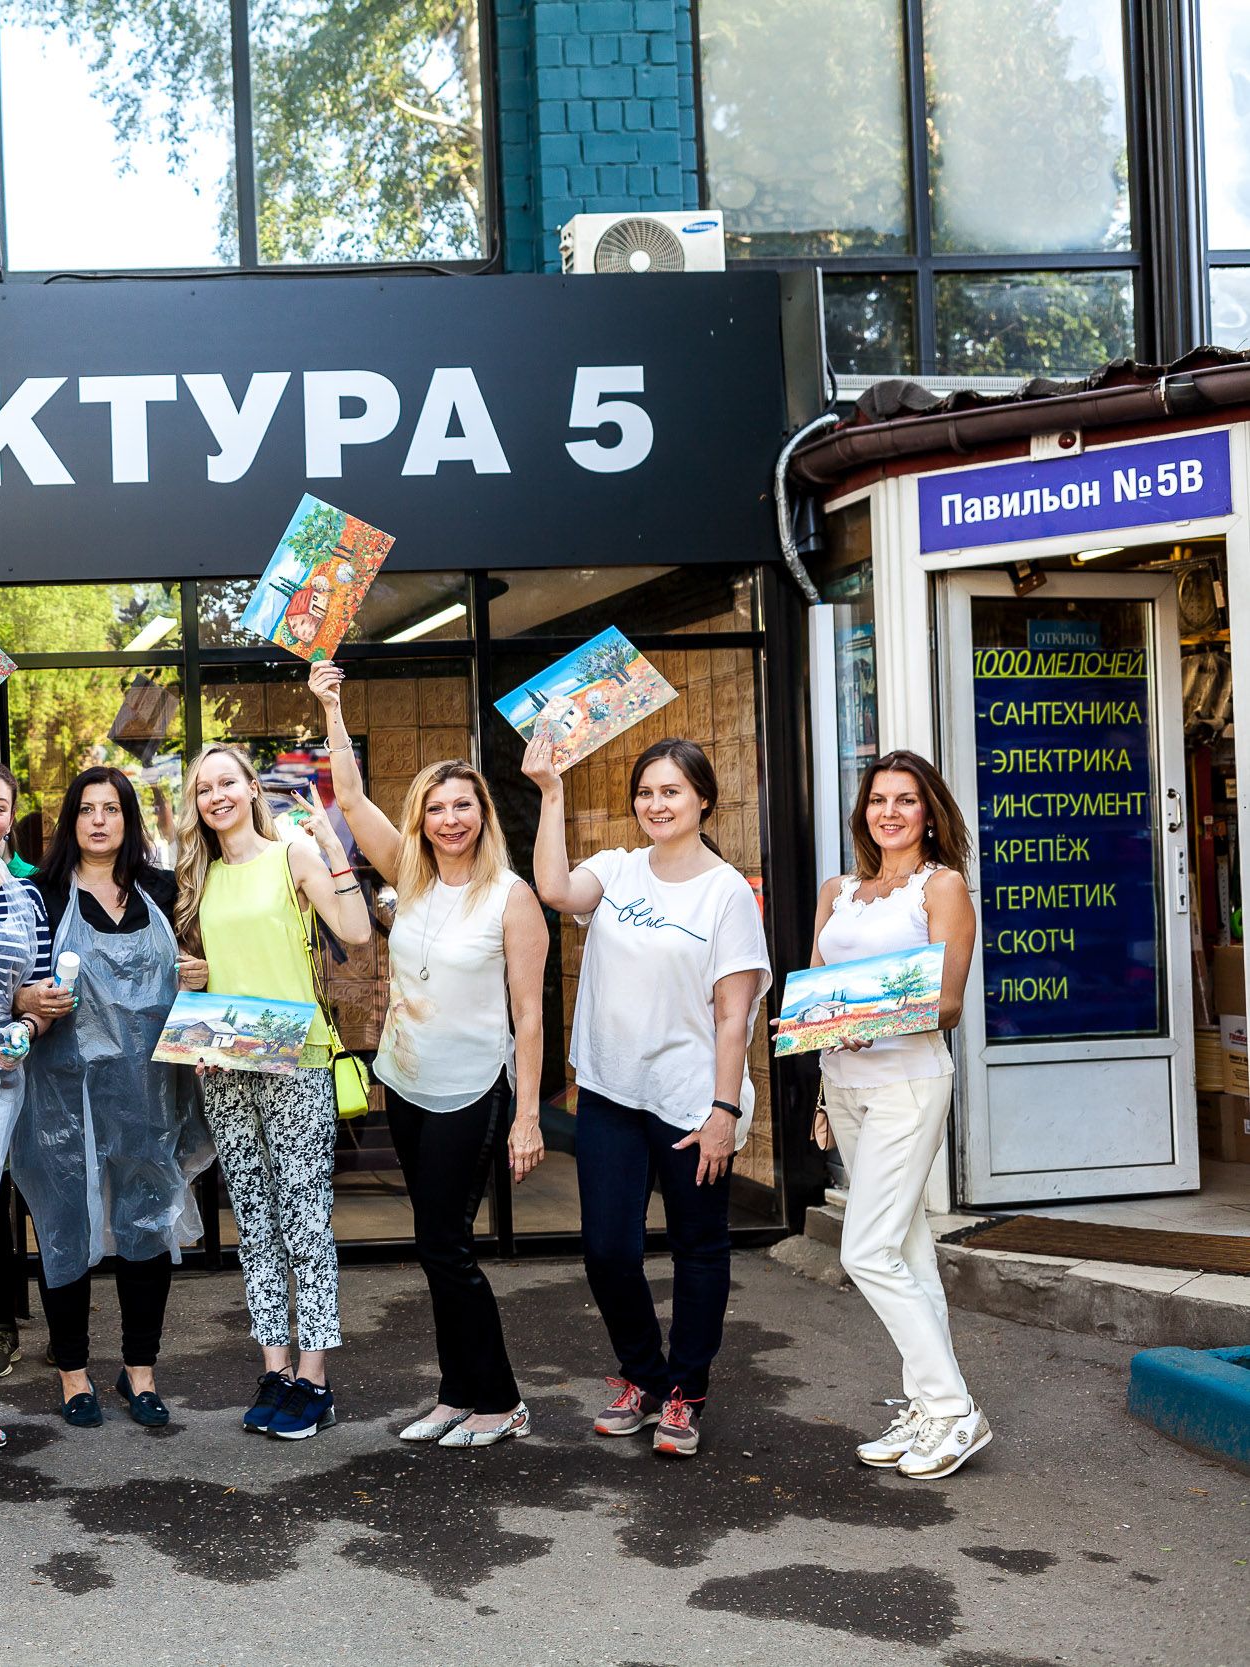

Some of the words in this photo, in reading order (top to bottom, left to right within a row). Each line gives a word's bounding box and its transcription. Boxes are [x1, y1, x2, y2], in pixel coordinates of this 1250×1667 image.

[565, 365, 655, 474] 5
[940, 480, 1101, 527] Павильон
[974, 649, 1032, 677] 1000
[1036, 648, 1145, 677] МЕЛОЧЕЙ
